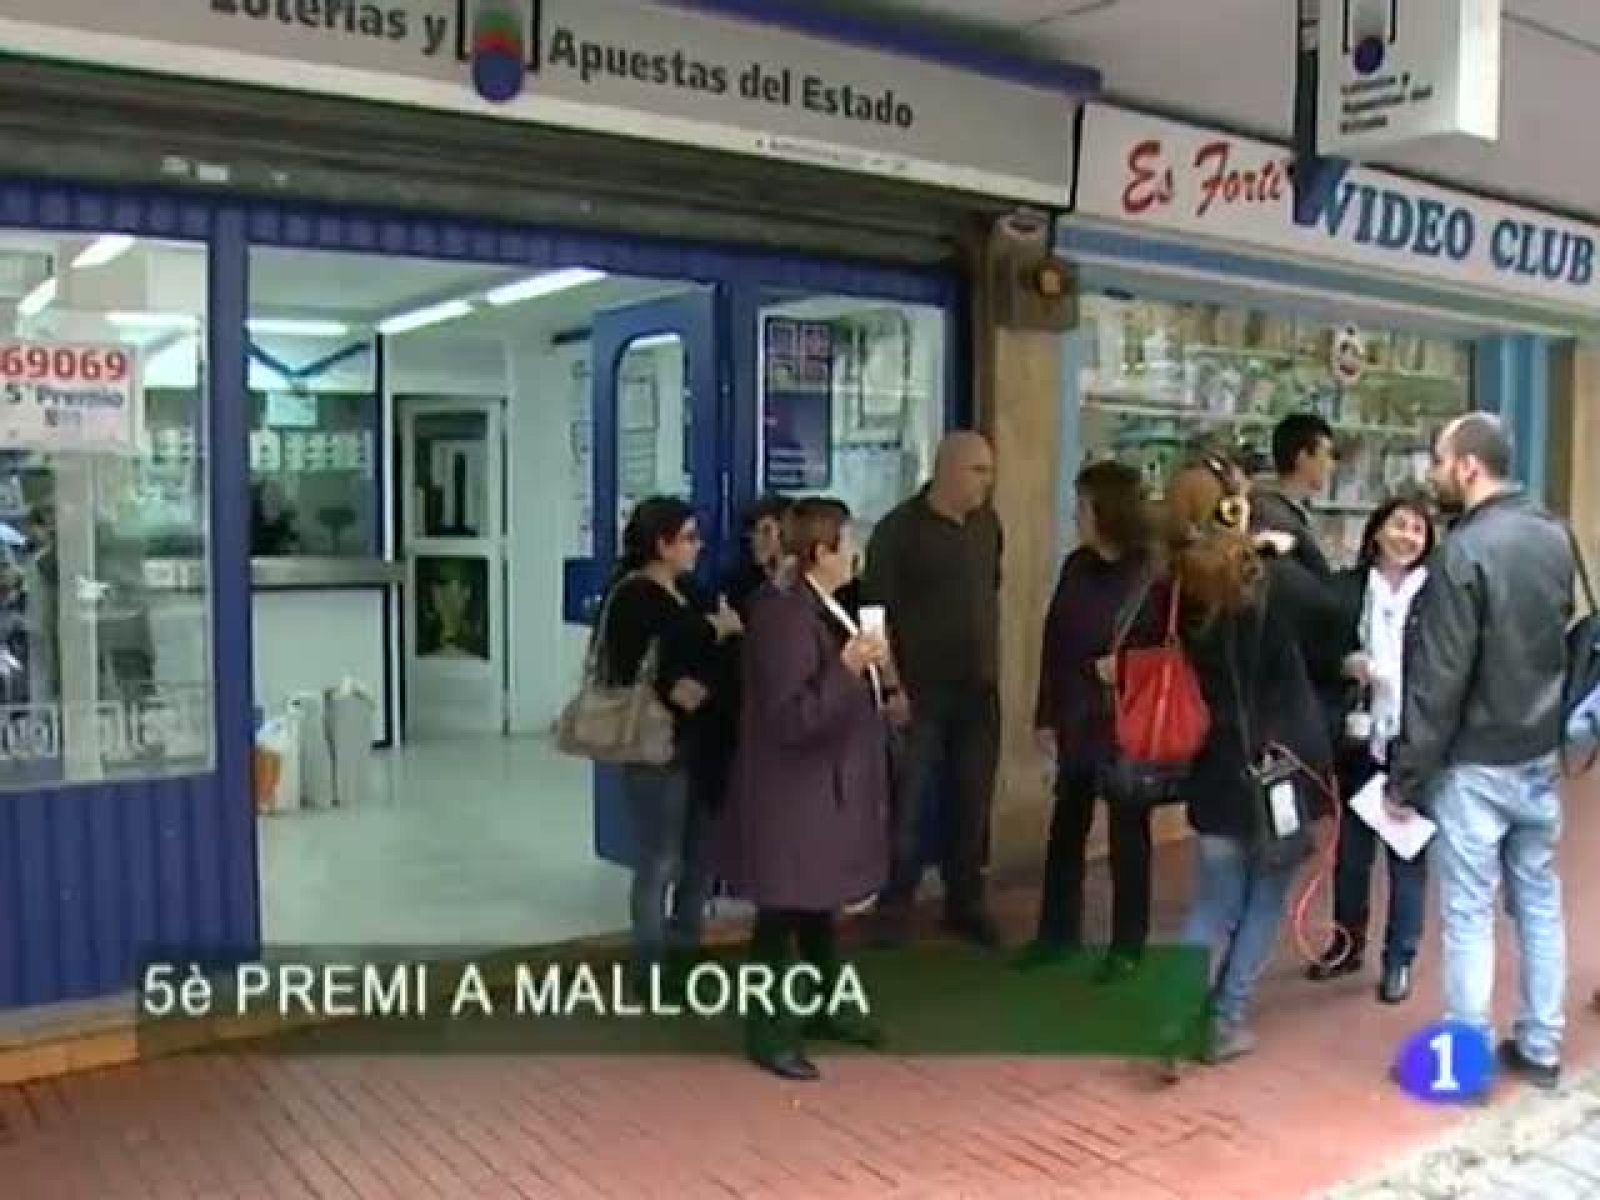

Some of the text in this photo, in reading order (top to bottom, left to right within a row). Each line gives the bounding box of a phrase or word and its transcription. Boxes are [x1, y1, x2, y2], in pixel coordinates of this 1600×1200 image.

[421, 14, 447, 56] y
[548, 27, 914, 129] Apuestas del Estado
[1122, 139, 1174, 214] Es
[1316, 180, 1595, 286] VIDEO CLUB
[0, 344, 125, 381] 69069
